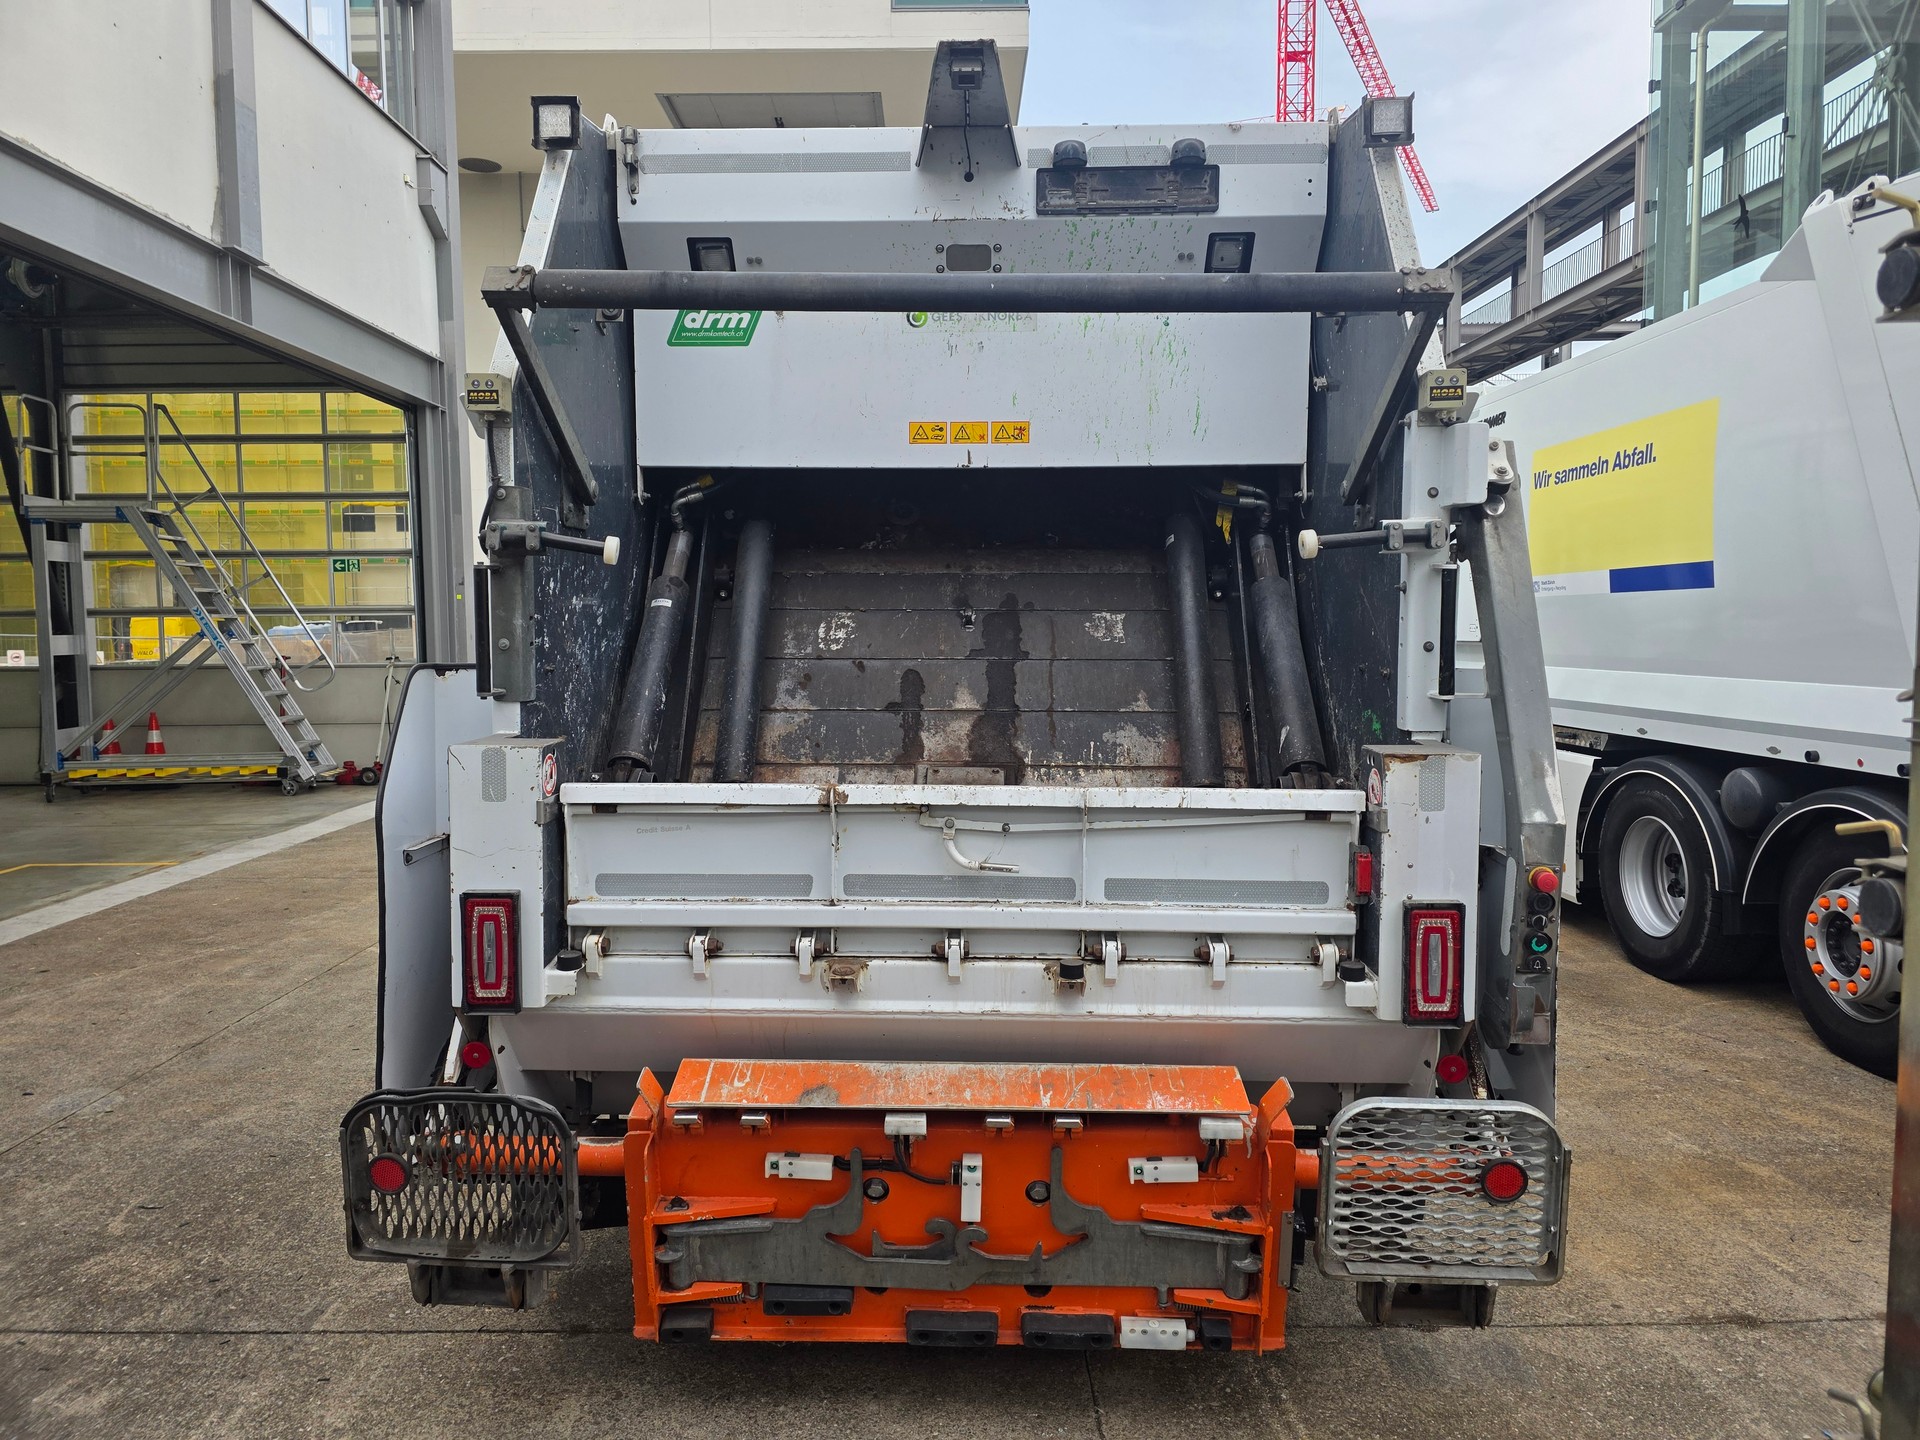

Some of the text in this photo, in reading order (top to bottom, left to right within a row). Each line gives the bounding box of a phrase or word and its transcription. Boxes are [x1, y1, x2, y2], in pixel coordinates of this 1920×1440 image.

[683, 309, 752, 328] drm
[1431, 388, 1462, 397] MOBA
[1534, 442, 1656, 490] Wir sammeln Abfall.
[660, 825, 683, 833] Suisse
